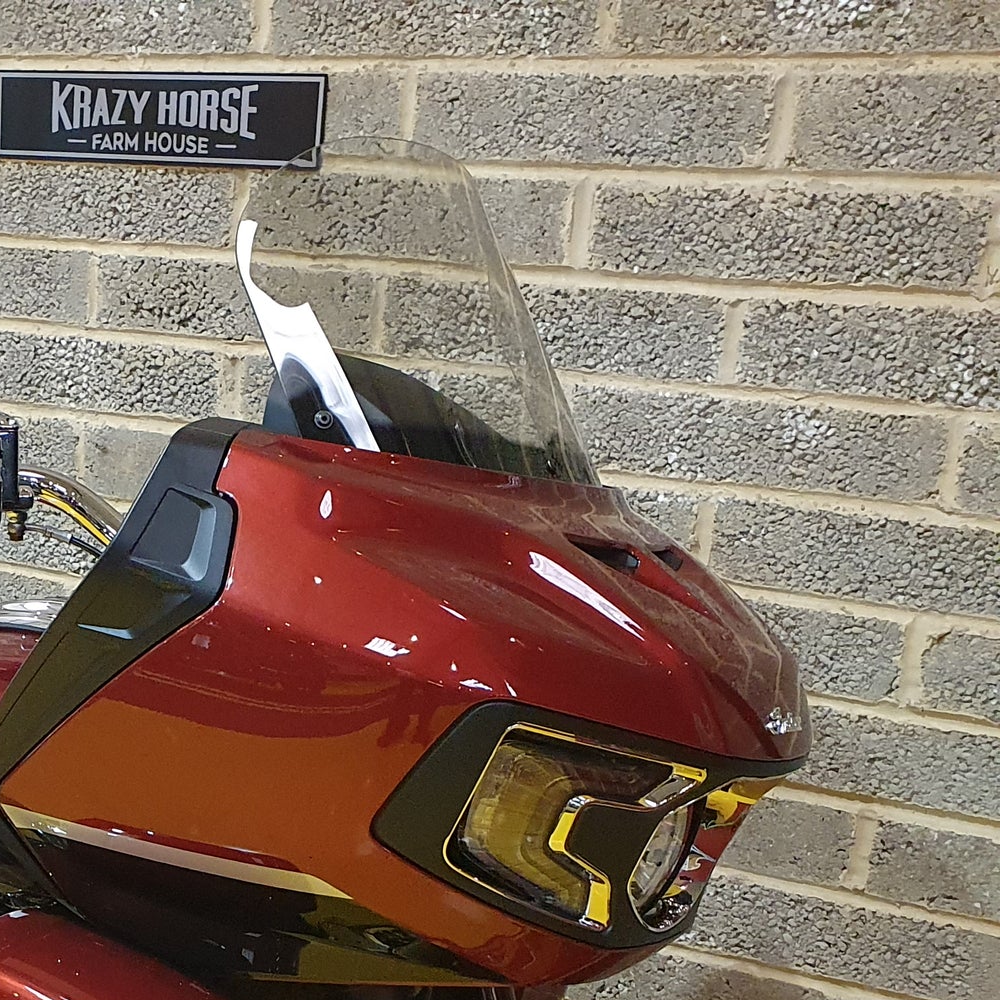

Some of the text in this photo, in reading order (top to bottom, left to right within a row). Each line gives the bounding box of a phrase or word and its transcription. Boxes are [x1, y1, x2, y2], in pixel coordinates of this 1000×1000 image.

[51, 80, 259, 140] KRAZY HORSE
[91, 132, 209, 154] FARM HOUSE
